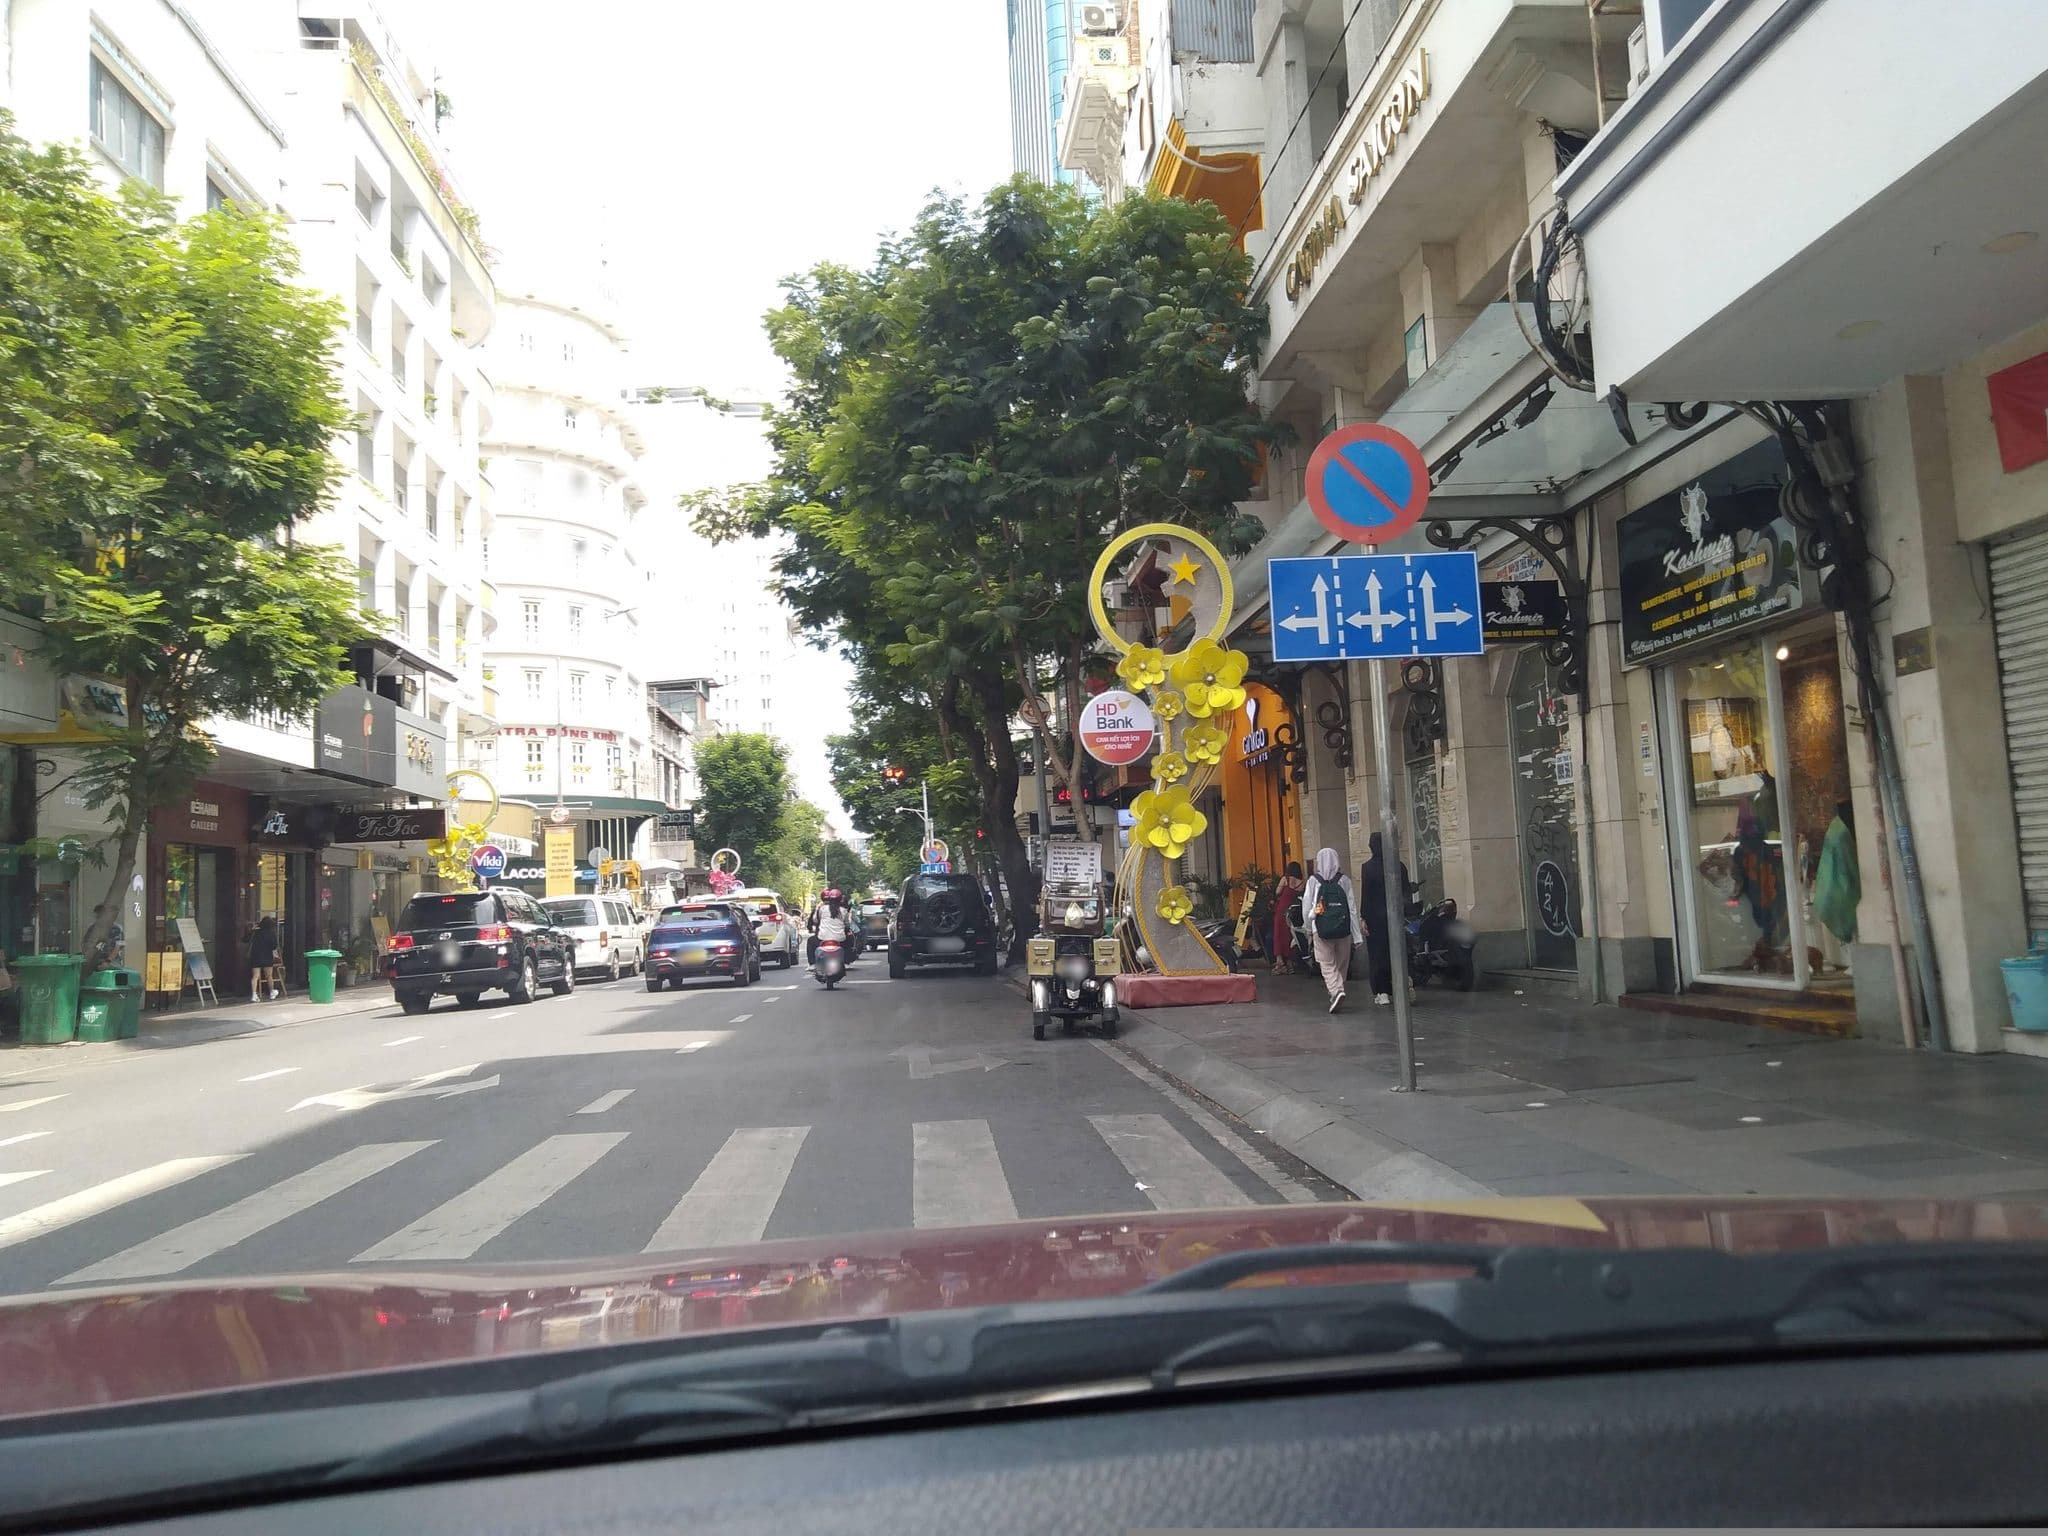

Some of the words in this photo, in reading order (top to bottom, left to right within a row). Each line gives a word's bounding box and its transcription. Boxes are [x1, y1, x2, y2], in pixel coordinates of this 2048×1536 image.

[1348, 47, 1431, 206] SAIGON
[1663, 533, 1734, 578] Kashmir
[1721, 564, 1736, 578] AND
[1486, 611, 1544, 625] Kashmir
[1096, 703, 1118, 716] HD
[1097, 716, 1134, 729] Bank
[491, 727, 538, 736] ATRA
[190, 819, 219, 831] GALLERY
[474, 851, 502, 867] Vikki
[500, 868, 546, 879] LACOS
